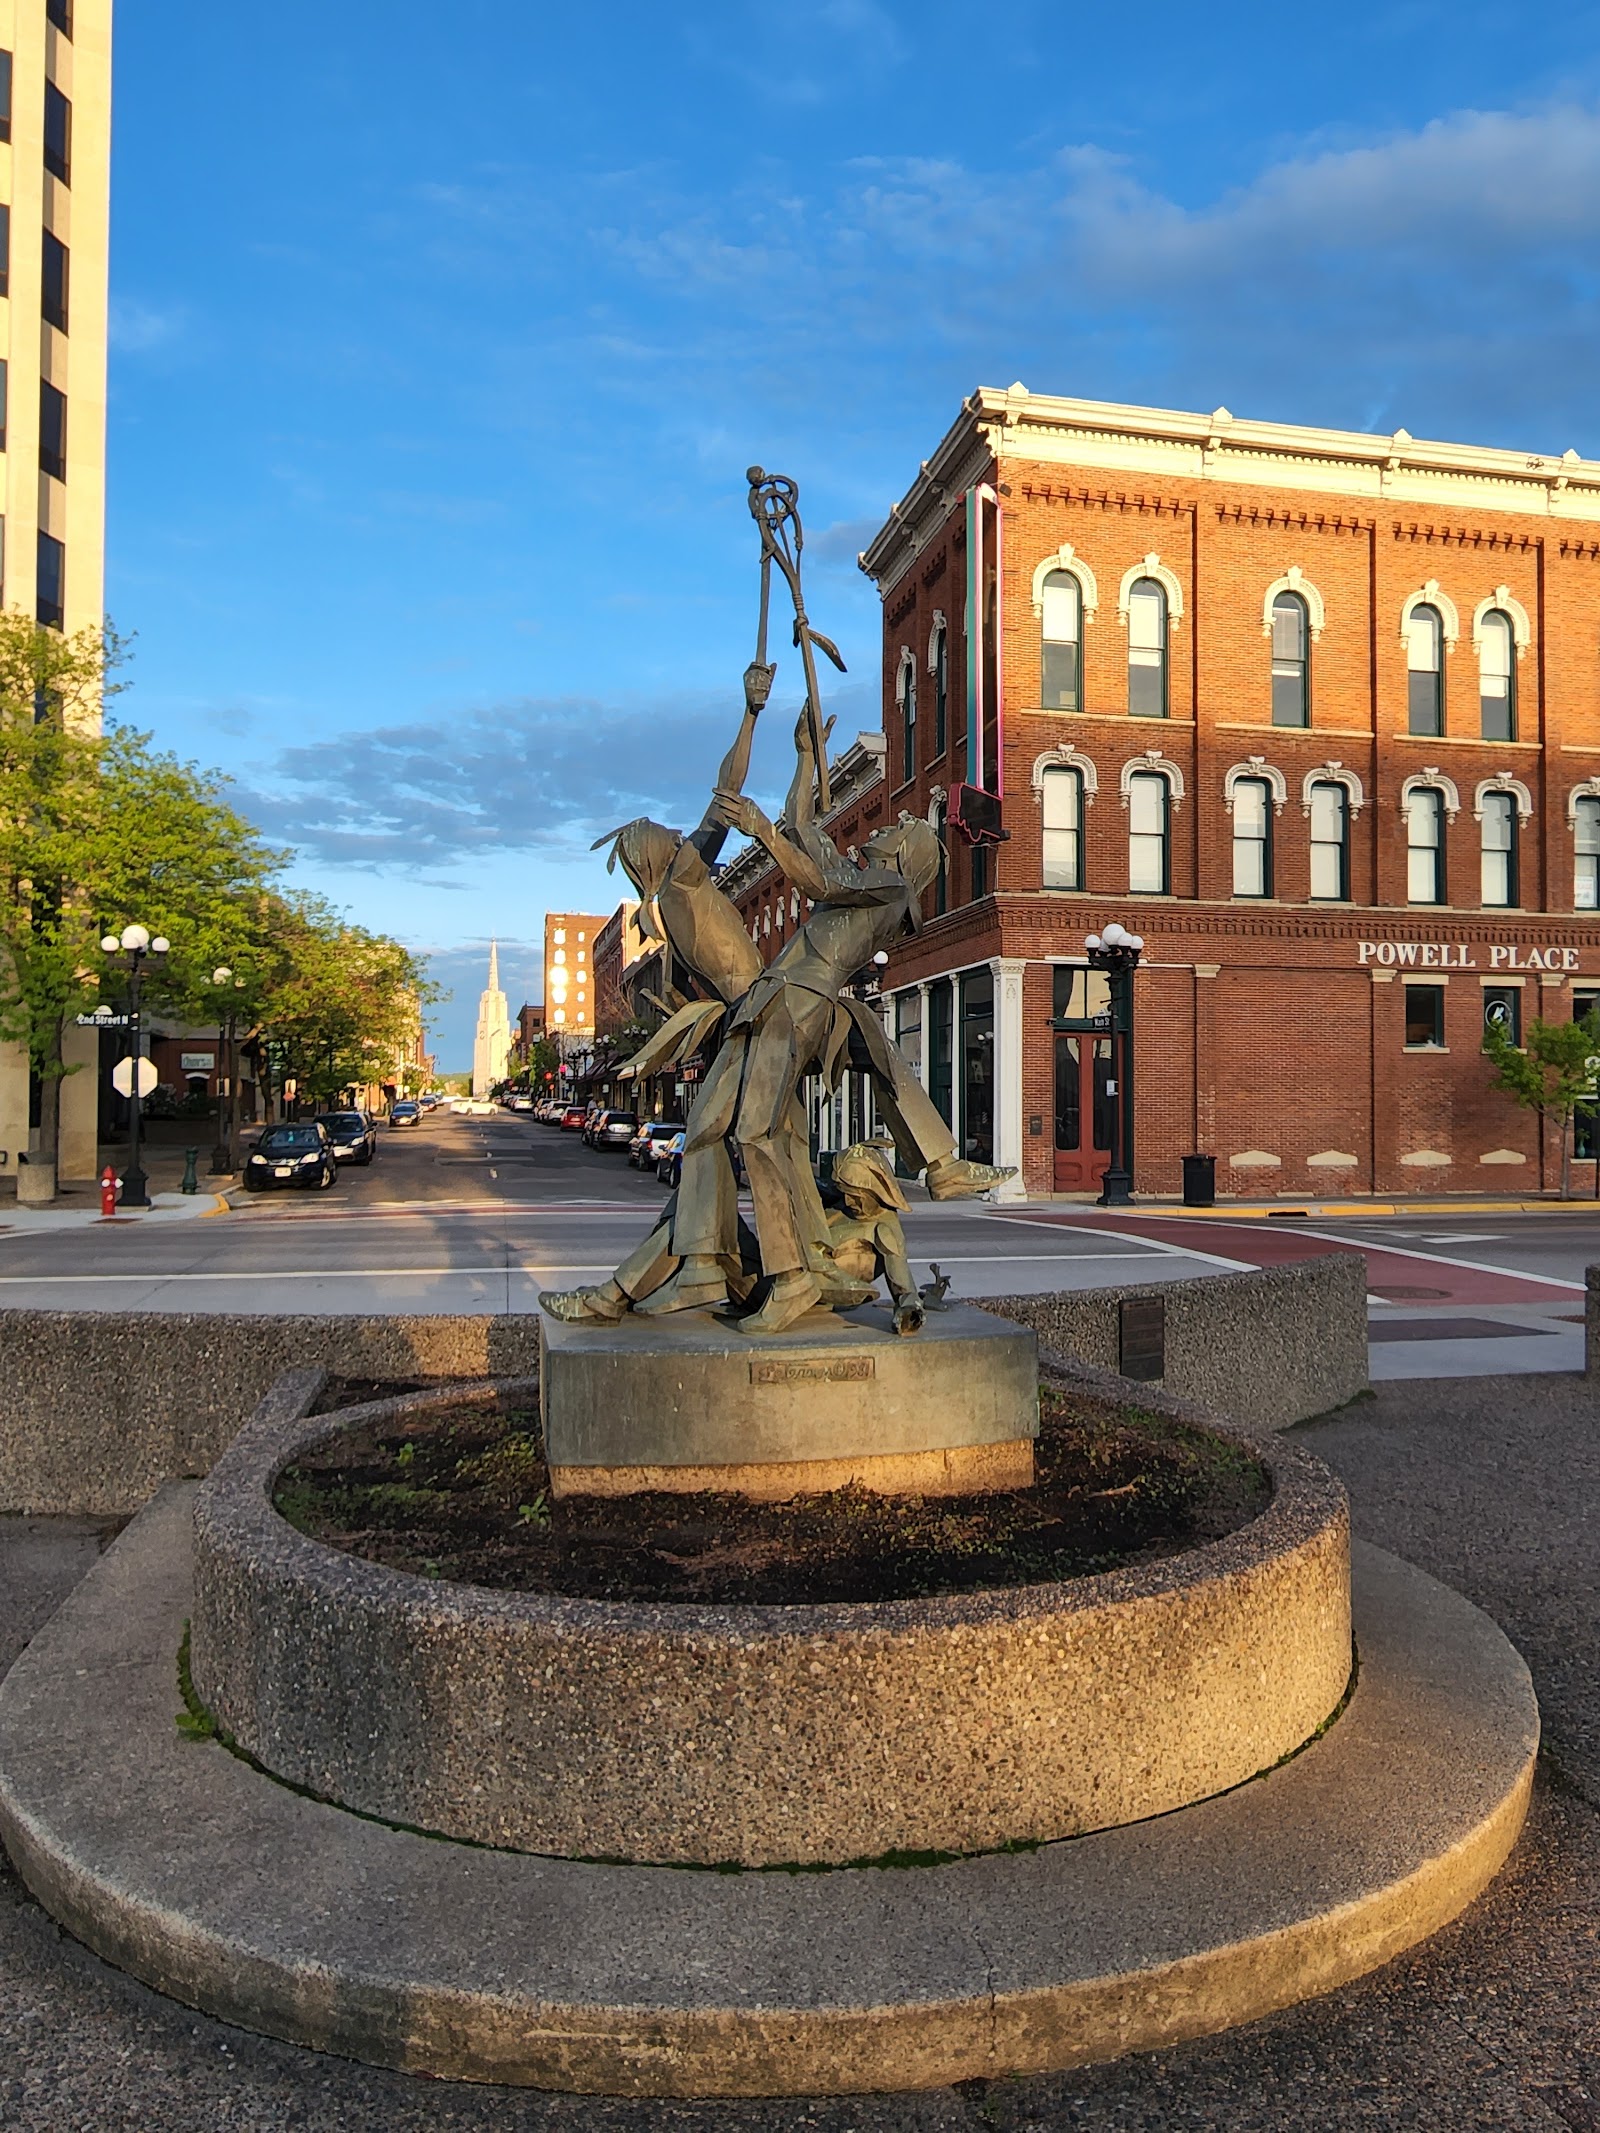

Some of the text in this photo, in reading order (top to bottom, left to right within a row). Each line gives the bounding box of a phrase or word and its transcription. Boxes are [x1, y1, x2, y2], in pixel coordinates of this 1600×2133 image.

[1356, 941, 1580, 970] POWELL PLACE
[95, 1015, 121, 1025] Street
